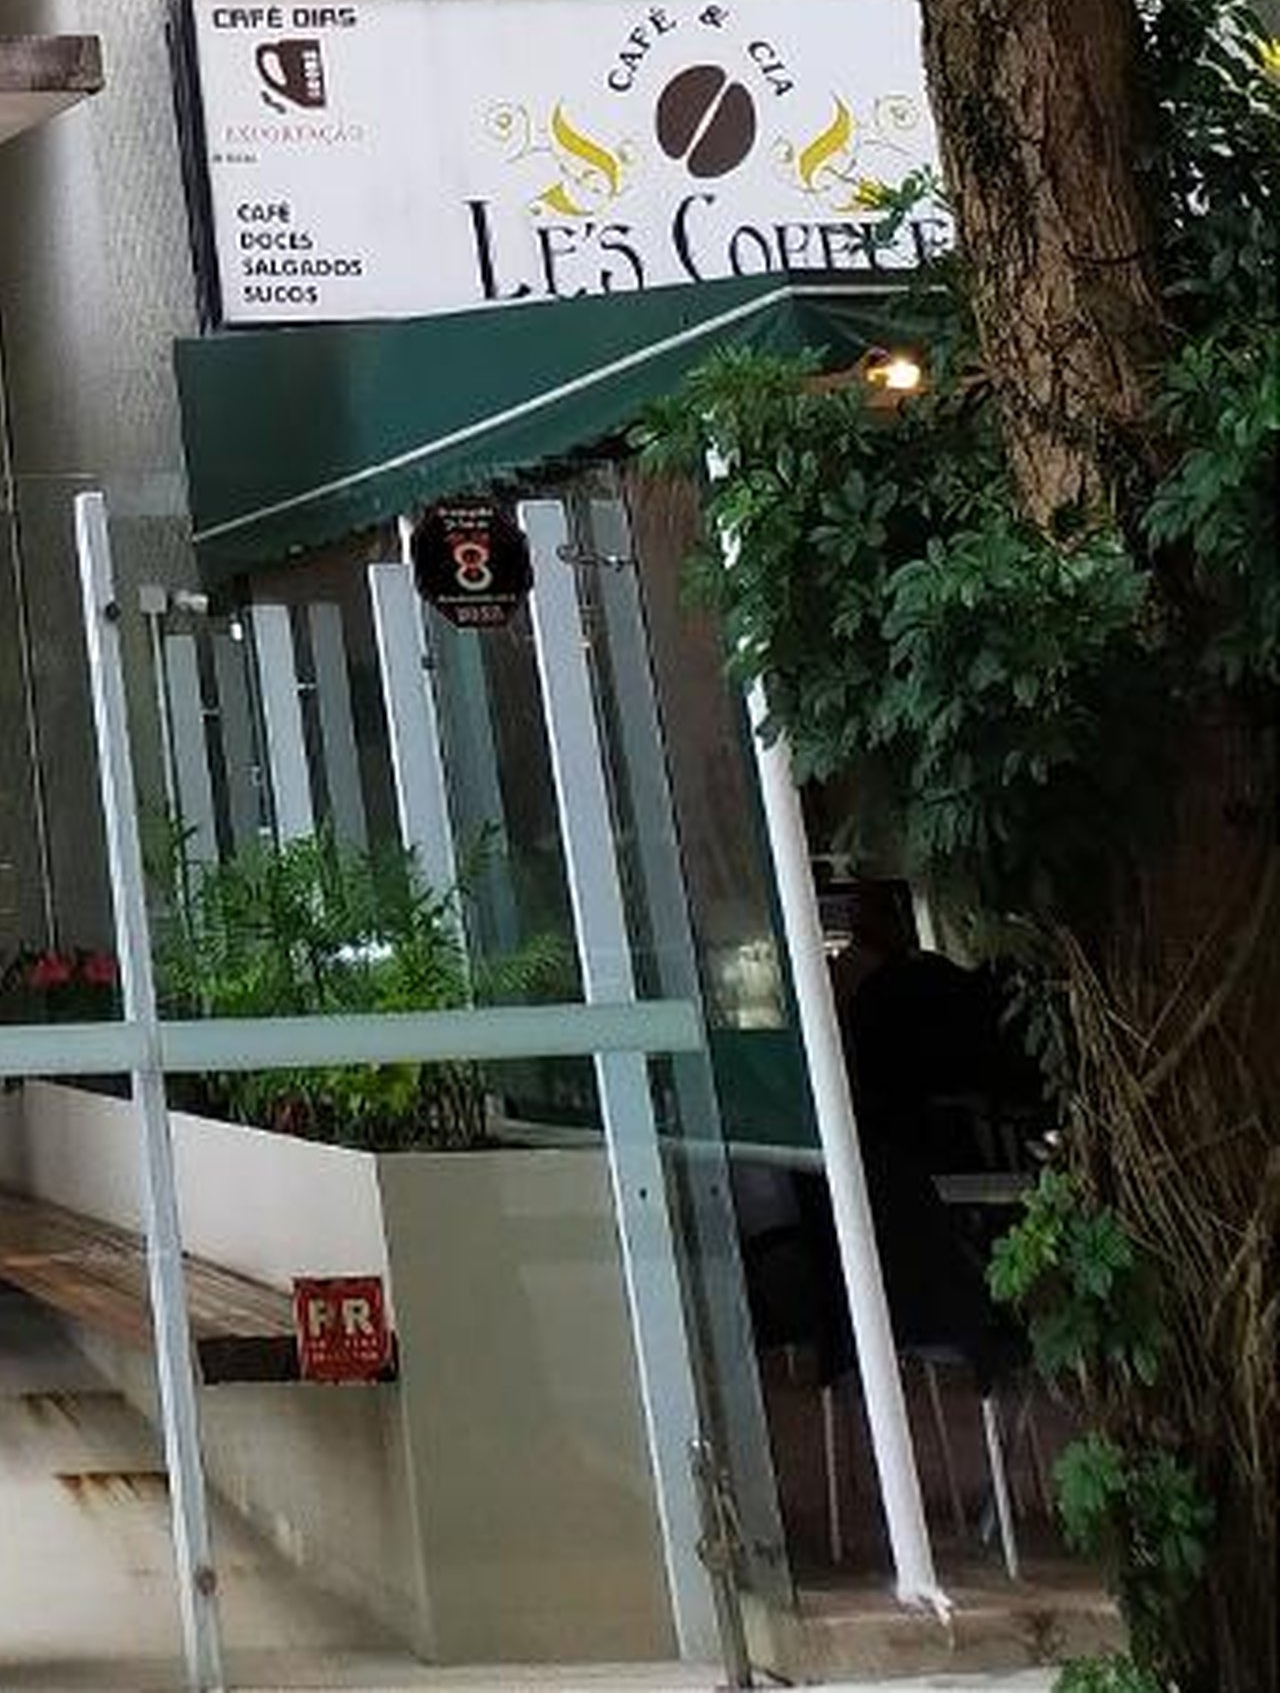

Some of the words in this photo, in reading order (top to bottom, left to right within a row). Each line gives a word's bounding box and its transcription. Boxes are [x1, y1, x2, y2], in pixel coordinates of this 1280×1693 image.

[293, 7, 357, 28] DIAS
[608, 6, 678, 92] CAFÉ
[698, 4, 729, 28] &
[747, 40, 794, 96] CIA
[236, 201, 291, 223] CAFÉ
[240, 230, 313, 251] DOCES
[241, 258, 364, 279] SALGADOS
[243, 285, 318, 306] SUCOS
